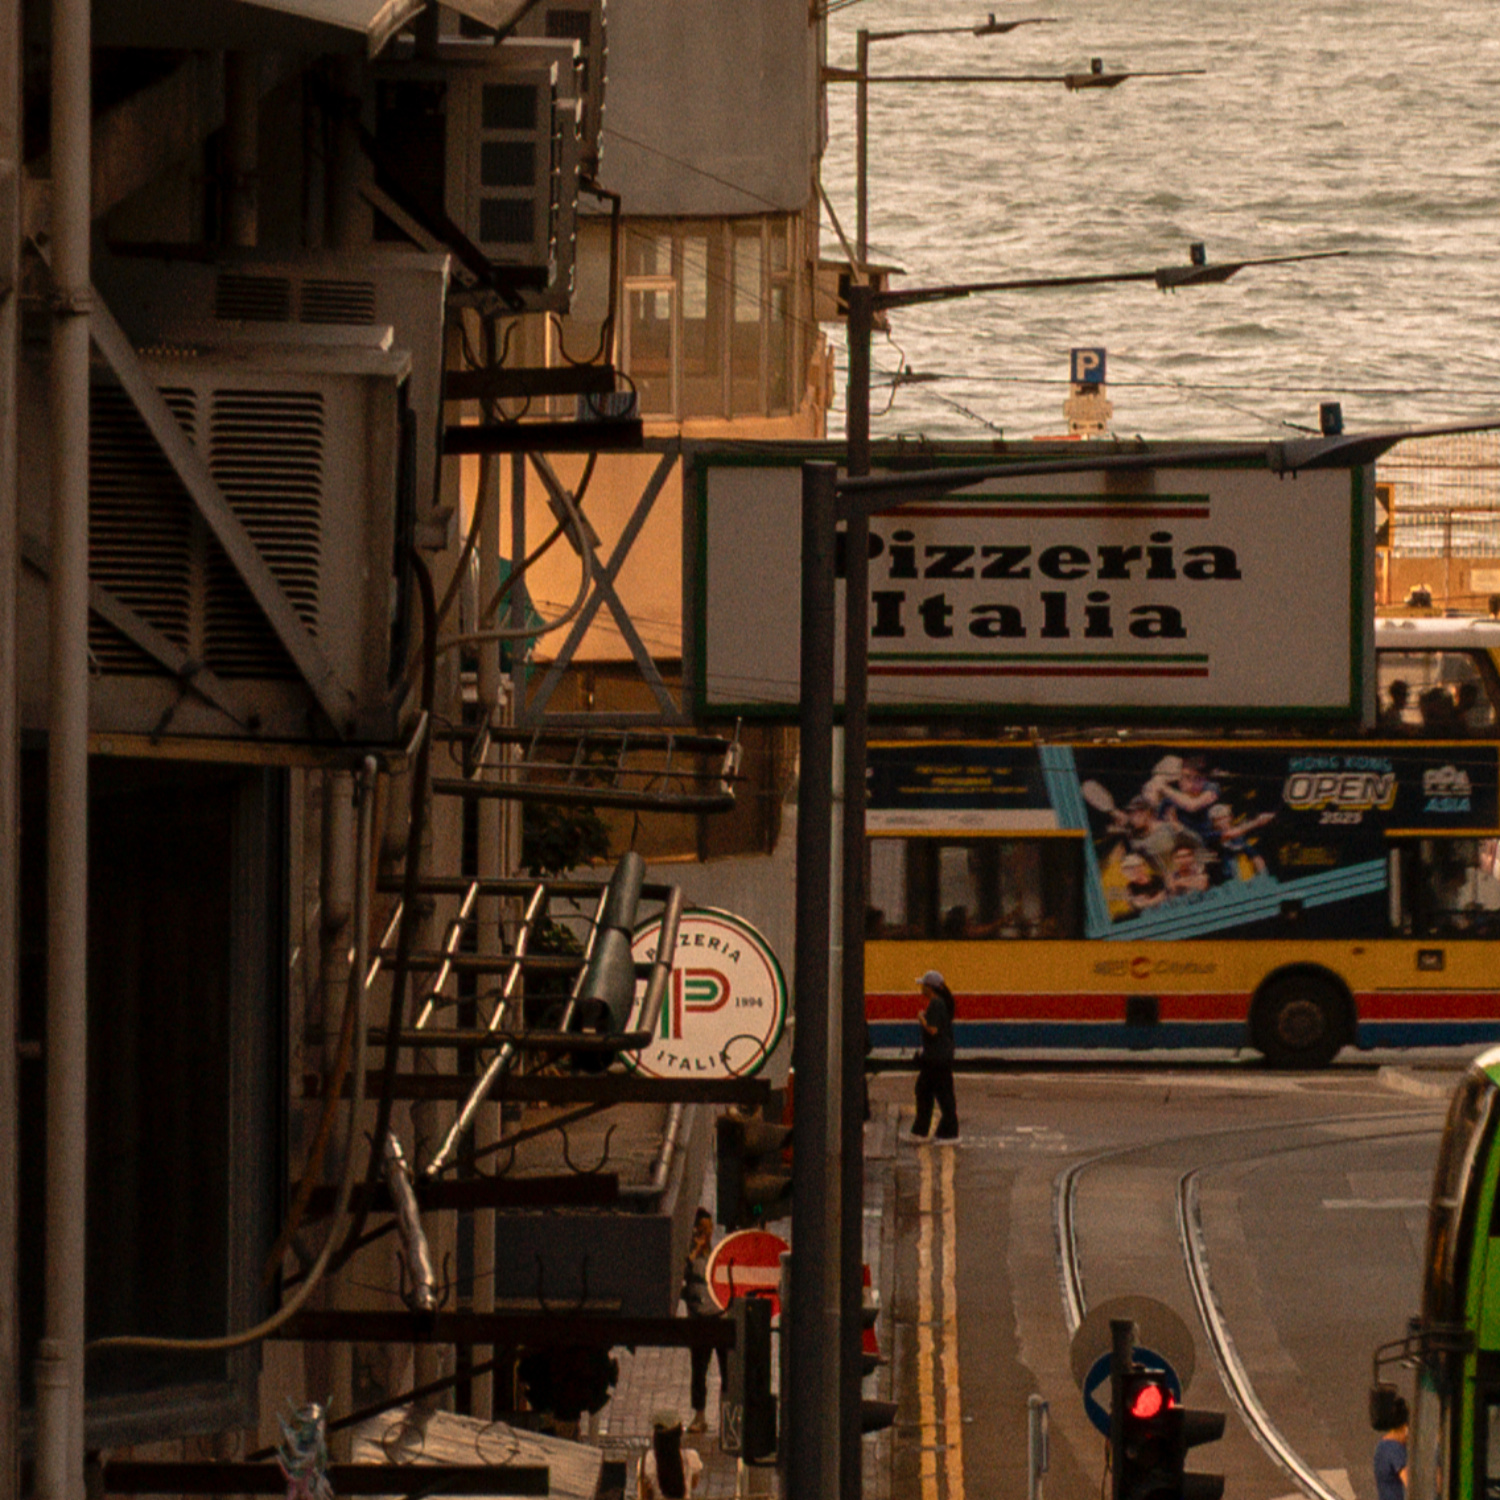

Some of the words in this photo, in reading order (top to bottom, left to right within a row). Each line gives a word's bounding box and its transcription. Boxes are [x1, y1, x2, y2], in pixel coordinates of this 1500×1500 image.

[1076, 350, 1100, 380] P
[871, 591, 1188, 639] Italia
[1283, 772, 1398, 810] OPEN
[645, 934, 742, 964] PZERIA
